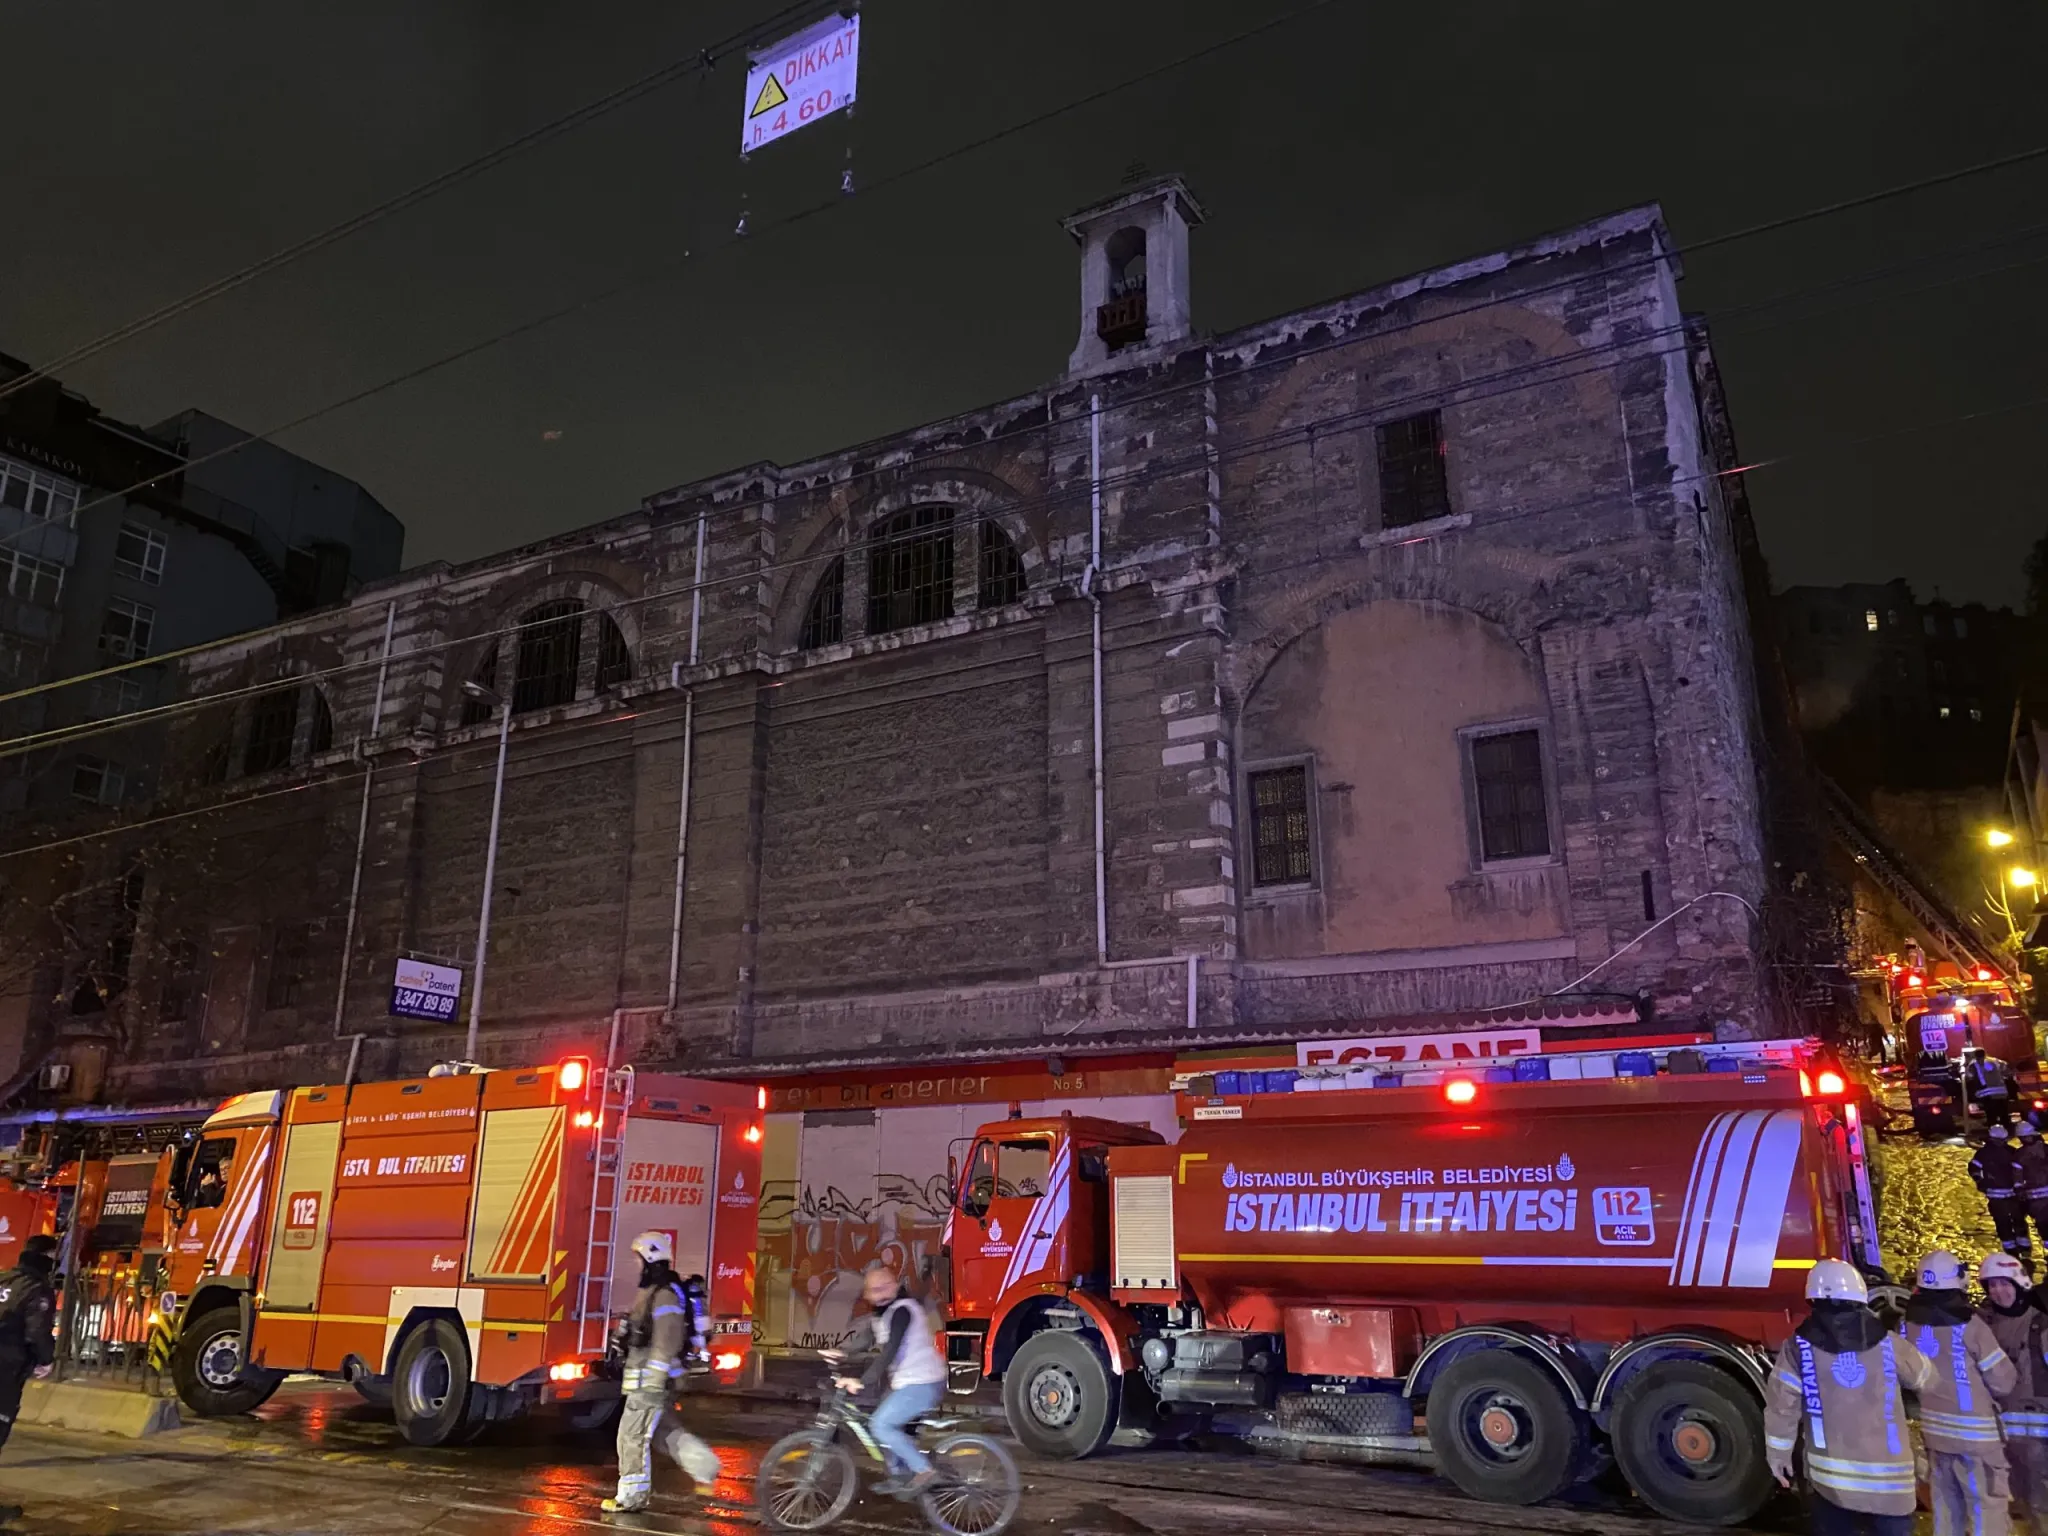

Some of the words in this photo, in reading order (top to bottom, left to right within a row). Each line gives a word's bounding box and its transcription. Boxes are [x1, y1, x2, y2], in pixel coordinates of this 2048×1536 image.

[428, 980, 455, 992] patent
[402, 991, 424, 1008] 347
[424, 995, 439, 1011] 89
[438, 997, 454, 1014] 89
[1926, 1032, 1942, 1042] 112
[627, 1163, 704, 1184] İSTANBUL
[1239, 1171, 1319, 1188] İSTANBUL
[1322, 1167, 1434, 1189] BÜYÜKŞEHİR
[1443, 1165, 1552, 1185] BELEDİYESİ
[625, 1185, 704, 1205] İTFAİYESİ
[1602, 1191, 1643, 1216] 112
[292, 1198, 317, 1225] 112
[1225, 1193, 1387, 1233] İSTANBUL
[1400, 1188, 1578, 1233] İTFAİYESİ
[1923, 1272, 1935, 1283] 20
